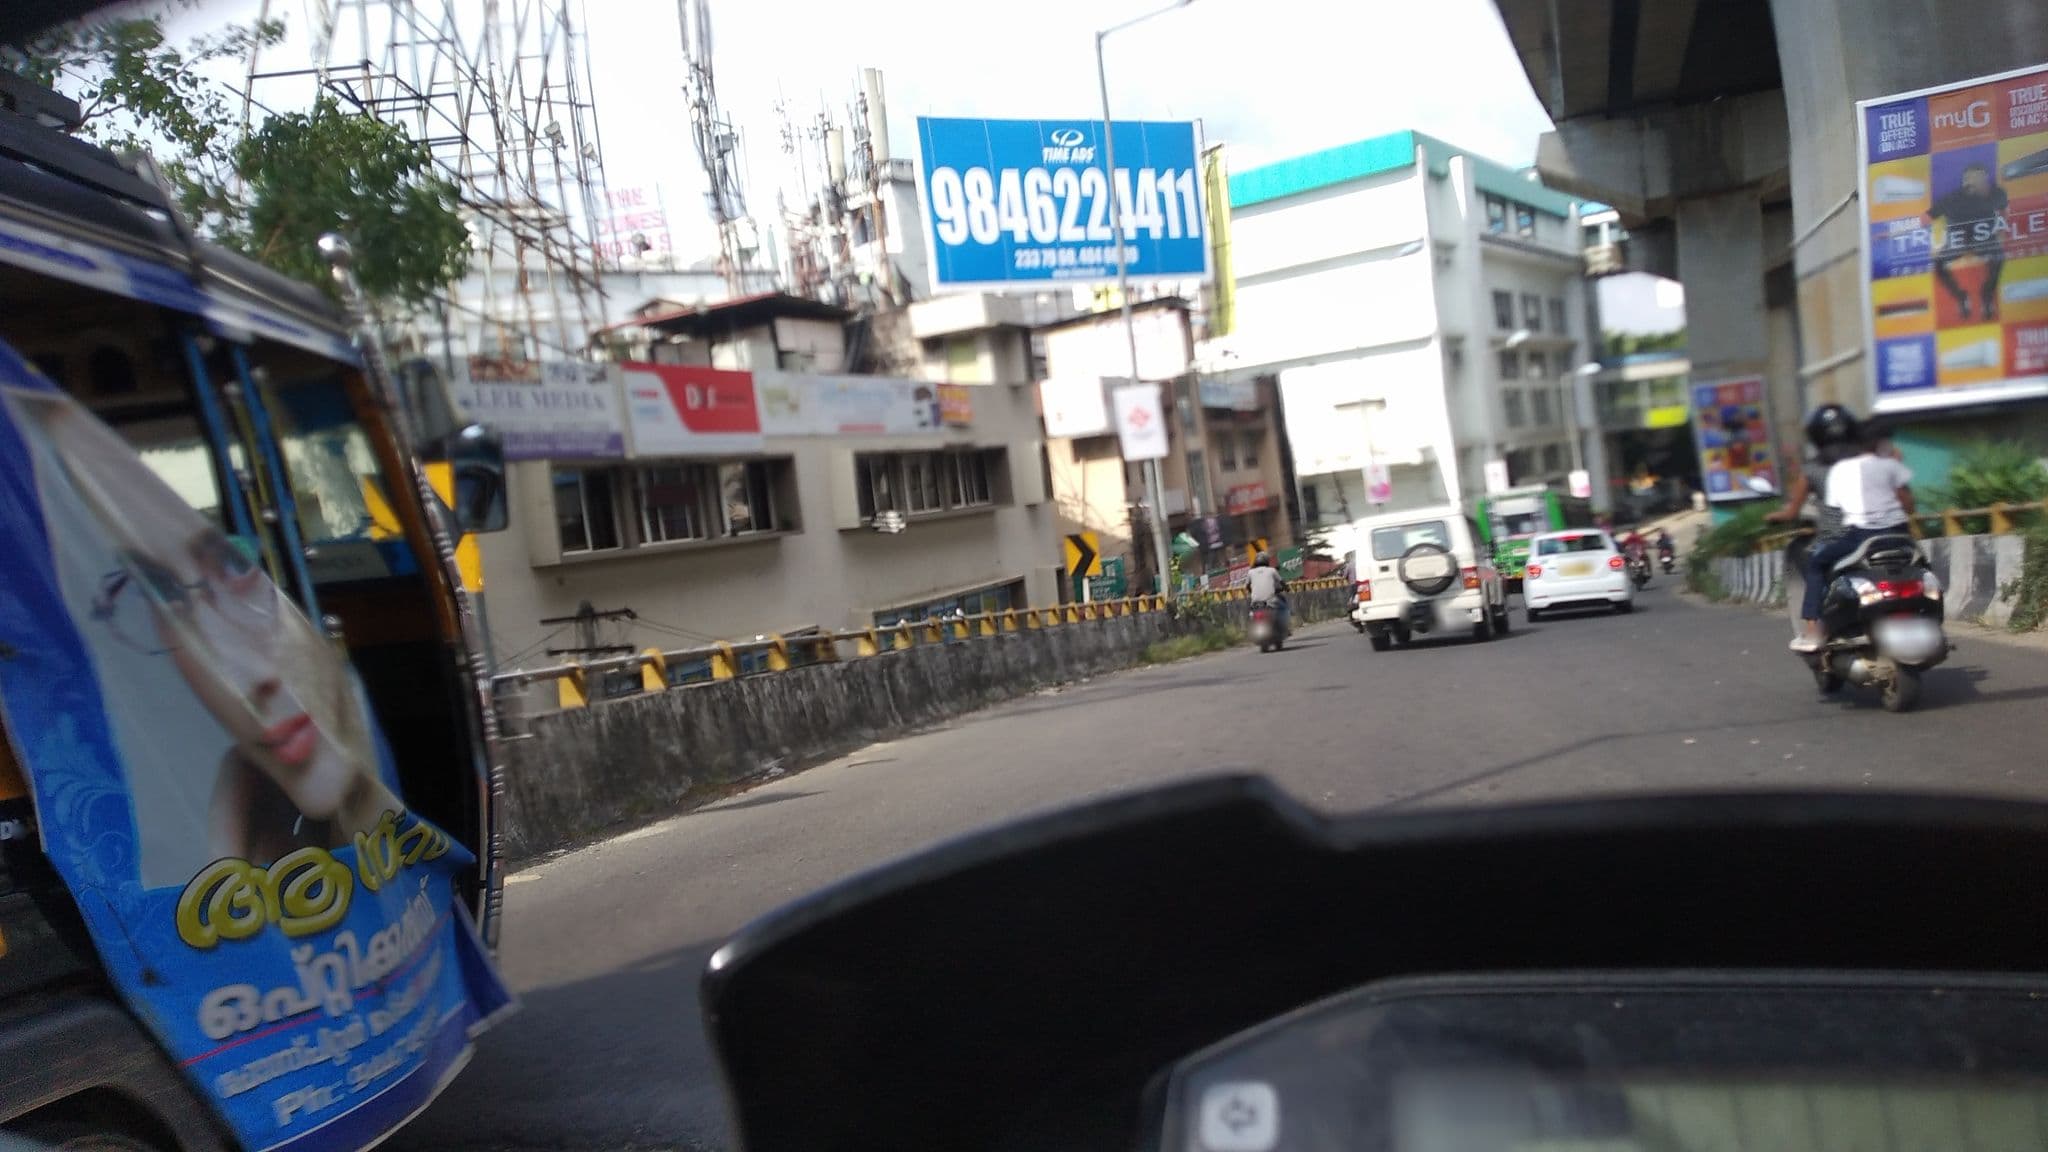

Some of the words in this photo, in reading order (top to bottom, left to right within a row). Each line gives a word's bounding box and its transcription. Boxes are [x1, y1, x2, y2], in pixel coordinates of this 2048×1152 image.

[2008, 83, 2048, 105] TRUE
[1880, 109, 1916, 131] TRUE
[1935, 100, 1991, 128] myG
[1880, 126, 1917, 143] OFFERS
[1042, 146, 1070, 164] TIME
[1071, 146, 1095, 163] ADS
[930, 167, 1200, 246] 9846224411
[1894, 228, 1966, 253] TRUE
[1974, 211, 2047, 241] SALE
